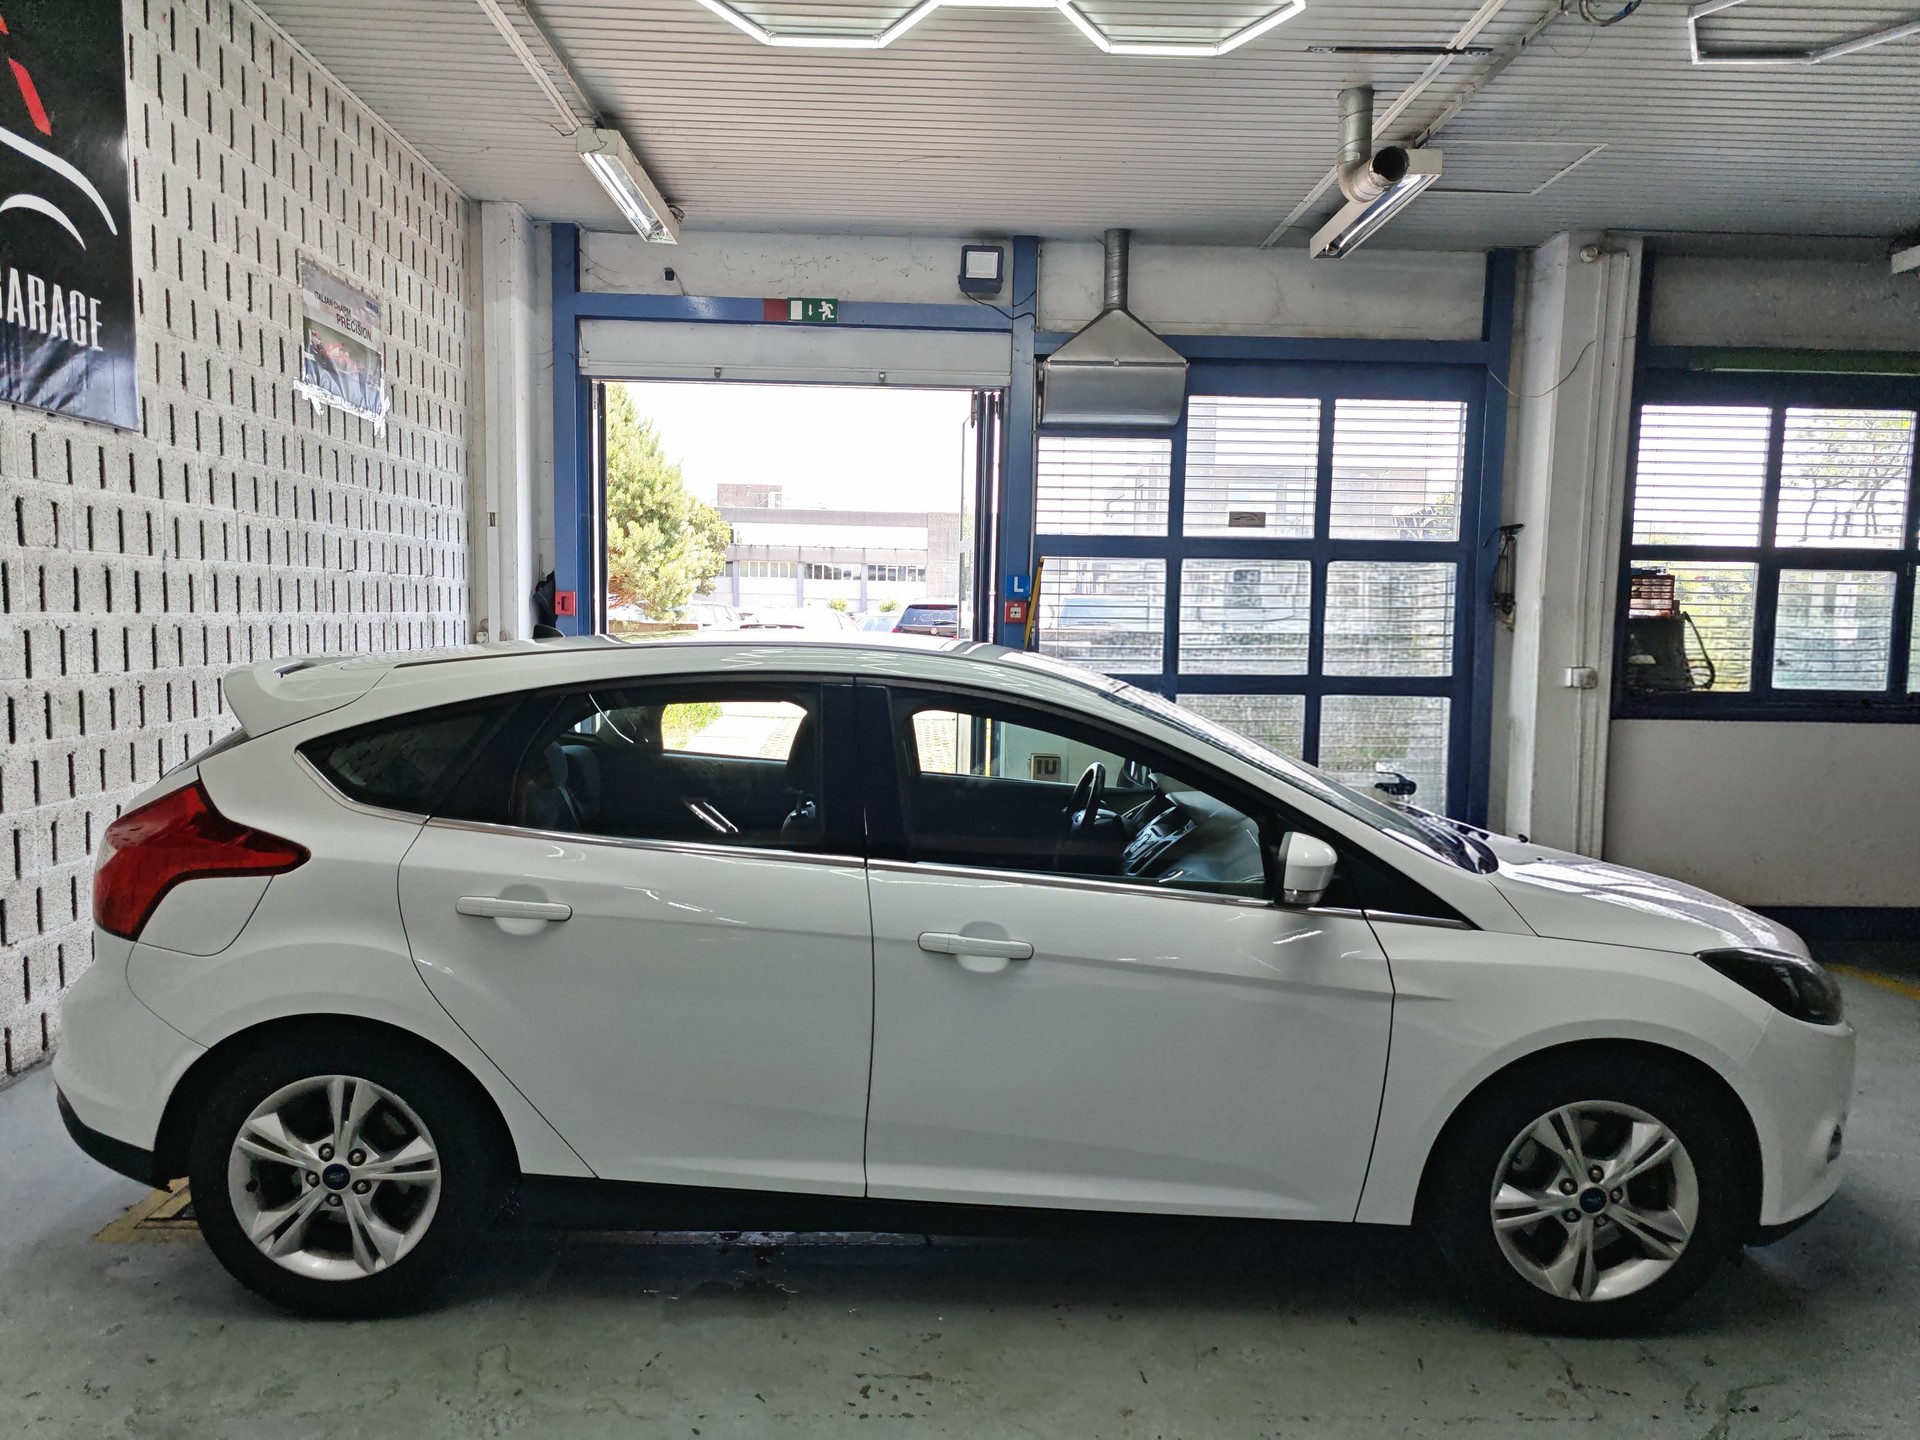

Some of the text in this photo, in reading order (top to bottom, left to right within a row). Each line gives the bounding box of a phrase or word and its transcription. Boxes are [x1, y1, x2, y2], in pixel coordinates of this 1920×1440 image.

[314, 290, 334, 307] ITALIAN
[0, 267, 103, 351] ARAGE
[1013, 576, 1024, 593] L
